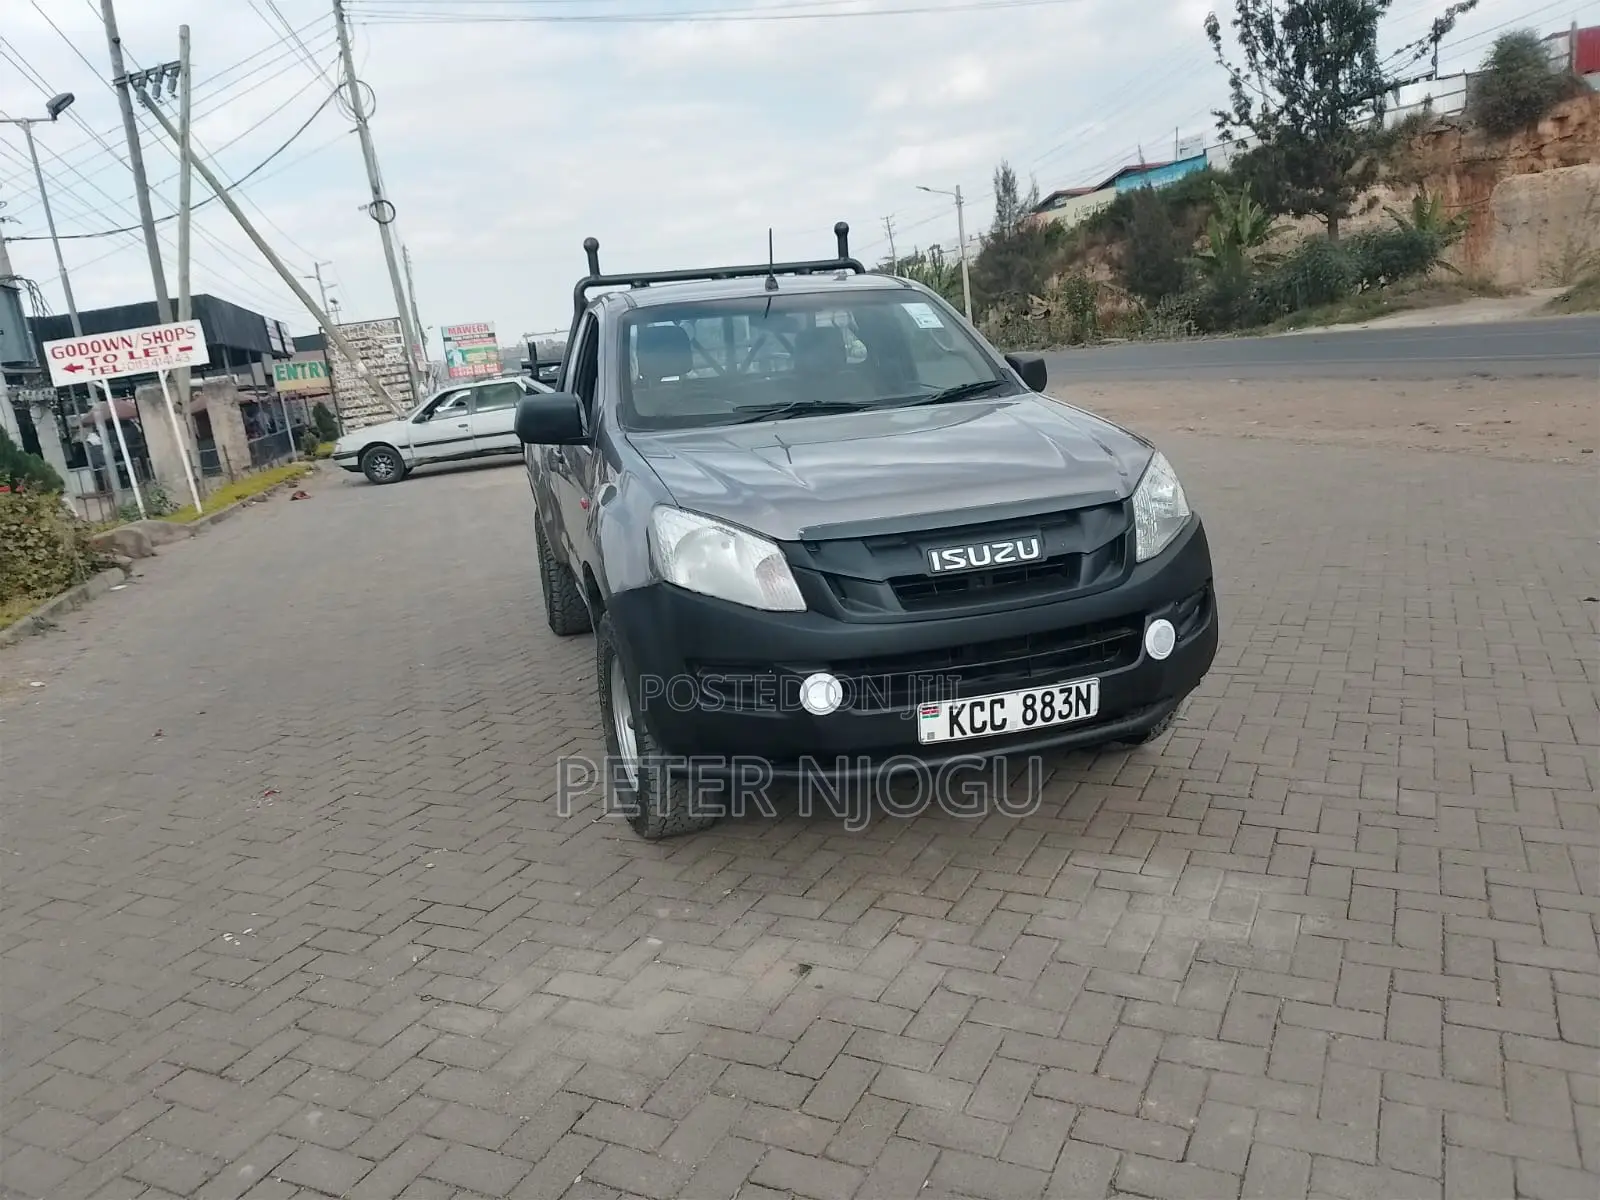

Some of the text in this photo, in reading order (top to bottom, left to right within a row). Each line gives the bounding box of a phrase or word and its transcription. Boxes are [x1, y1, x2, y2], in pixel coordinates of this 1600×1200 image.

[51, 325, 196, 359] GODOWN/SHOPS
[447, 323, 489, 335] MAWEGA
[85, 344, 172, 366] TO LET
[275, 361, 330, 381] ENTRY
[930, 538, 1040, 572] ISUZU
[948, 683, 1092, 738] KCC 883N
